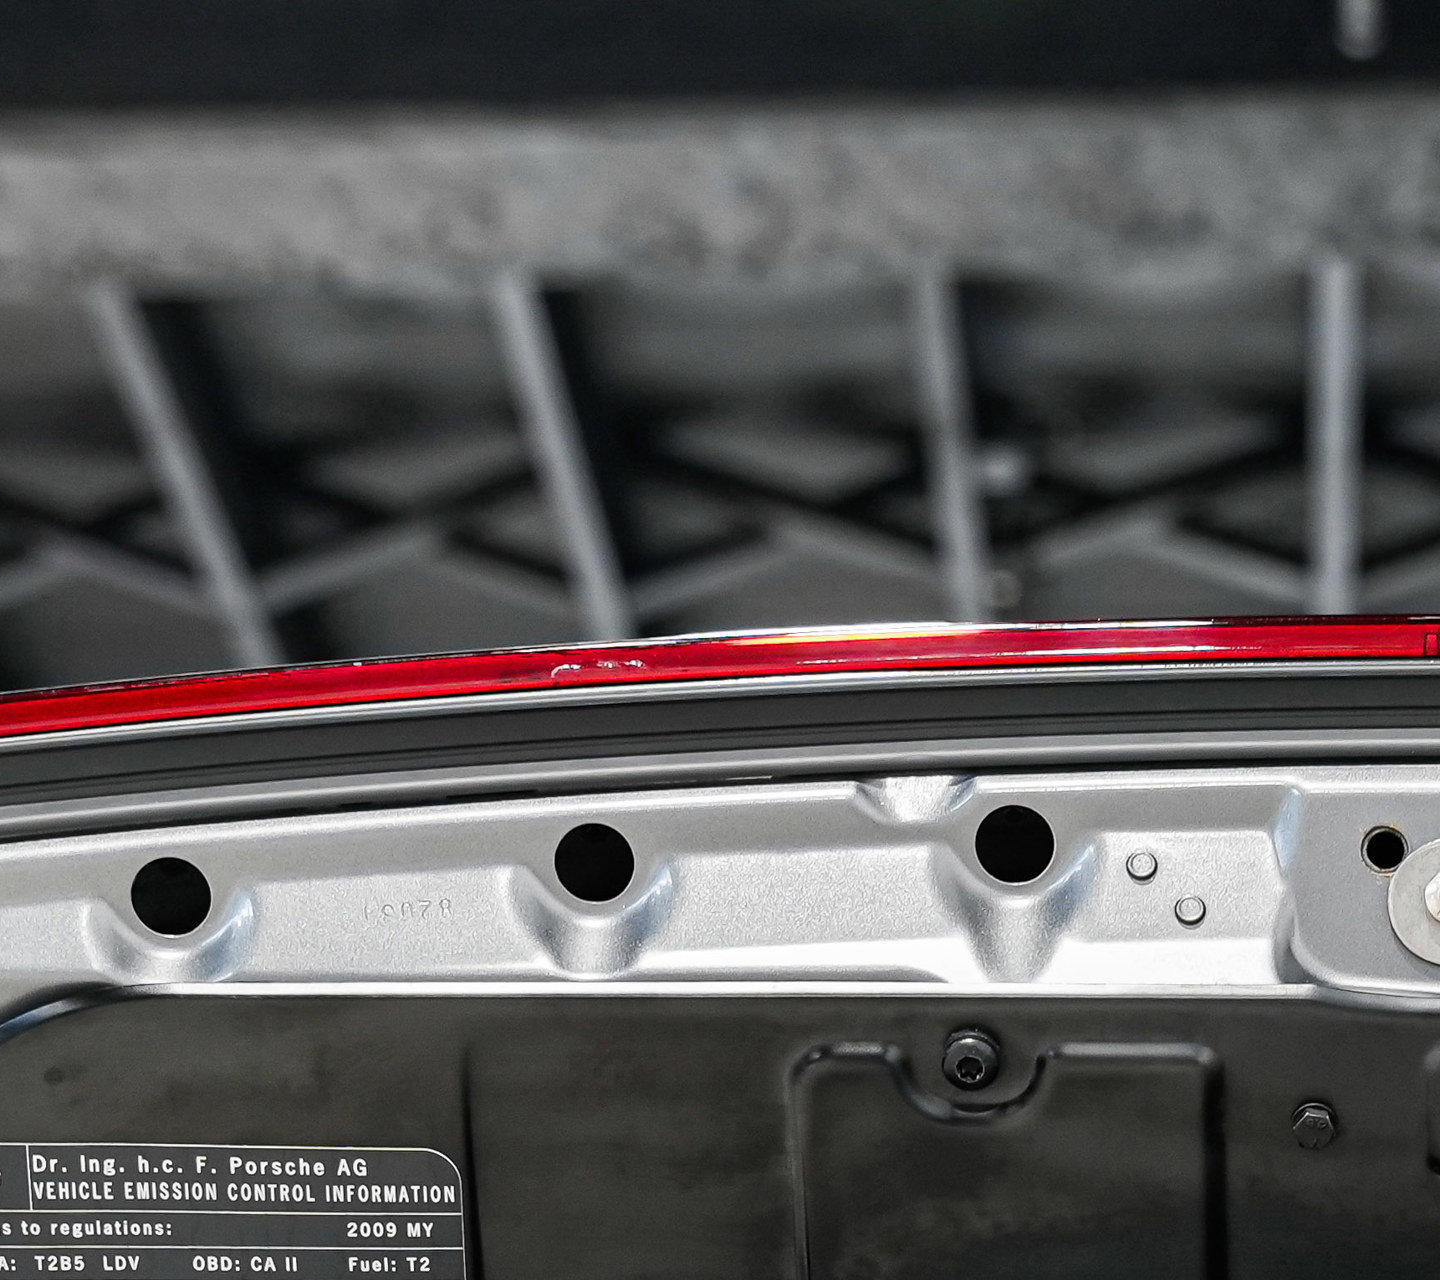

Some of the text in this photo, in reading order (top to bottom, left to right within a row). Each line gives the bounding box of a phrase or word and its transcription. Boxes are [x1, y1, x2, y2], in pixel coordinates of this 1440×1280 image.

[32, 1154, 368, 1177] Dr. Ing. h.c. F. Porsche AG
[32, 1181, 455, 1203] VEHICLE EMISSION CONTROL INFORMATION
[20, 1220, 41, 1236] to
[50, 1219, 172, 1239] regulations:
[346, 1221, 397, 1238] 2009
[406, 1222, 434, 1238] MY
[33, 1255, 85, 1271] T2B5
[102, 1255, 140, 1271] LDV
[192, 1255, 241, 1272] OBD:
[250, 1255, 277, 1272] CA
[285, 1256, 298, 1272] II
[348, 1256, 397, 1273] Fuel:
[405, 1256, 431, 1272] T2
